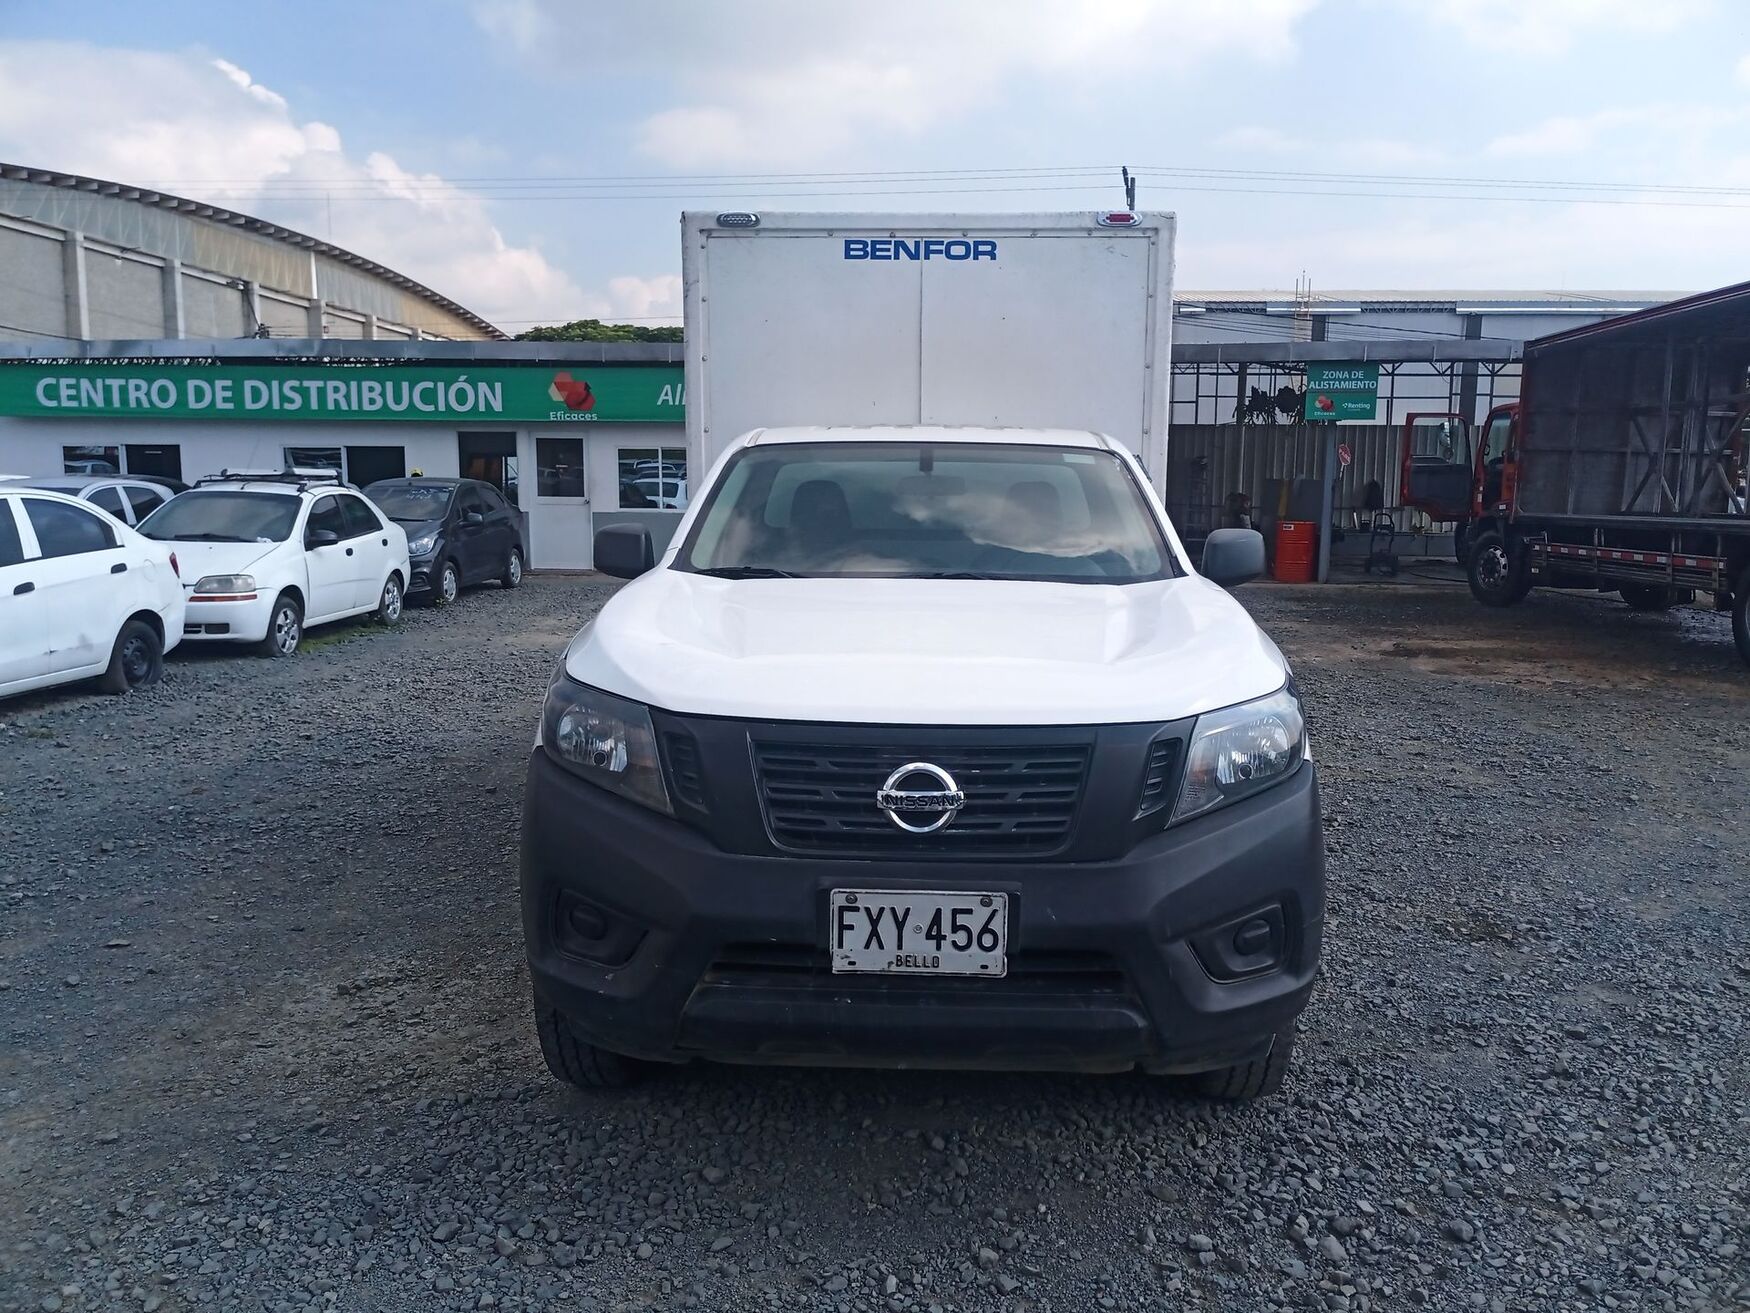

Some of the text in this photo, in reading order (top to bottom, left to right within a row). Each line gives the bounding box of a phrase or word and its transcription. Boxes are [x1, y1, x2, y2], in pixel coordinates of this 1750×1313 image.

[844, 239, 997, 261] BENFOR
[1323, 371, 1364, 379] ZONA DE
[1309, 380, 1376, 389] ALISTAMIENTO
[36, 375, 503, 412] CENTRO DE DISTRIBUCIÓN
[550, 411, 597, 421] Eficaces
[884, 793, 958, 807] NISSAN
[837, 905, 1000, 953] FXY 456
[895, 954, 940, 969] BELLO
